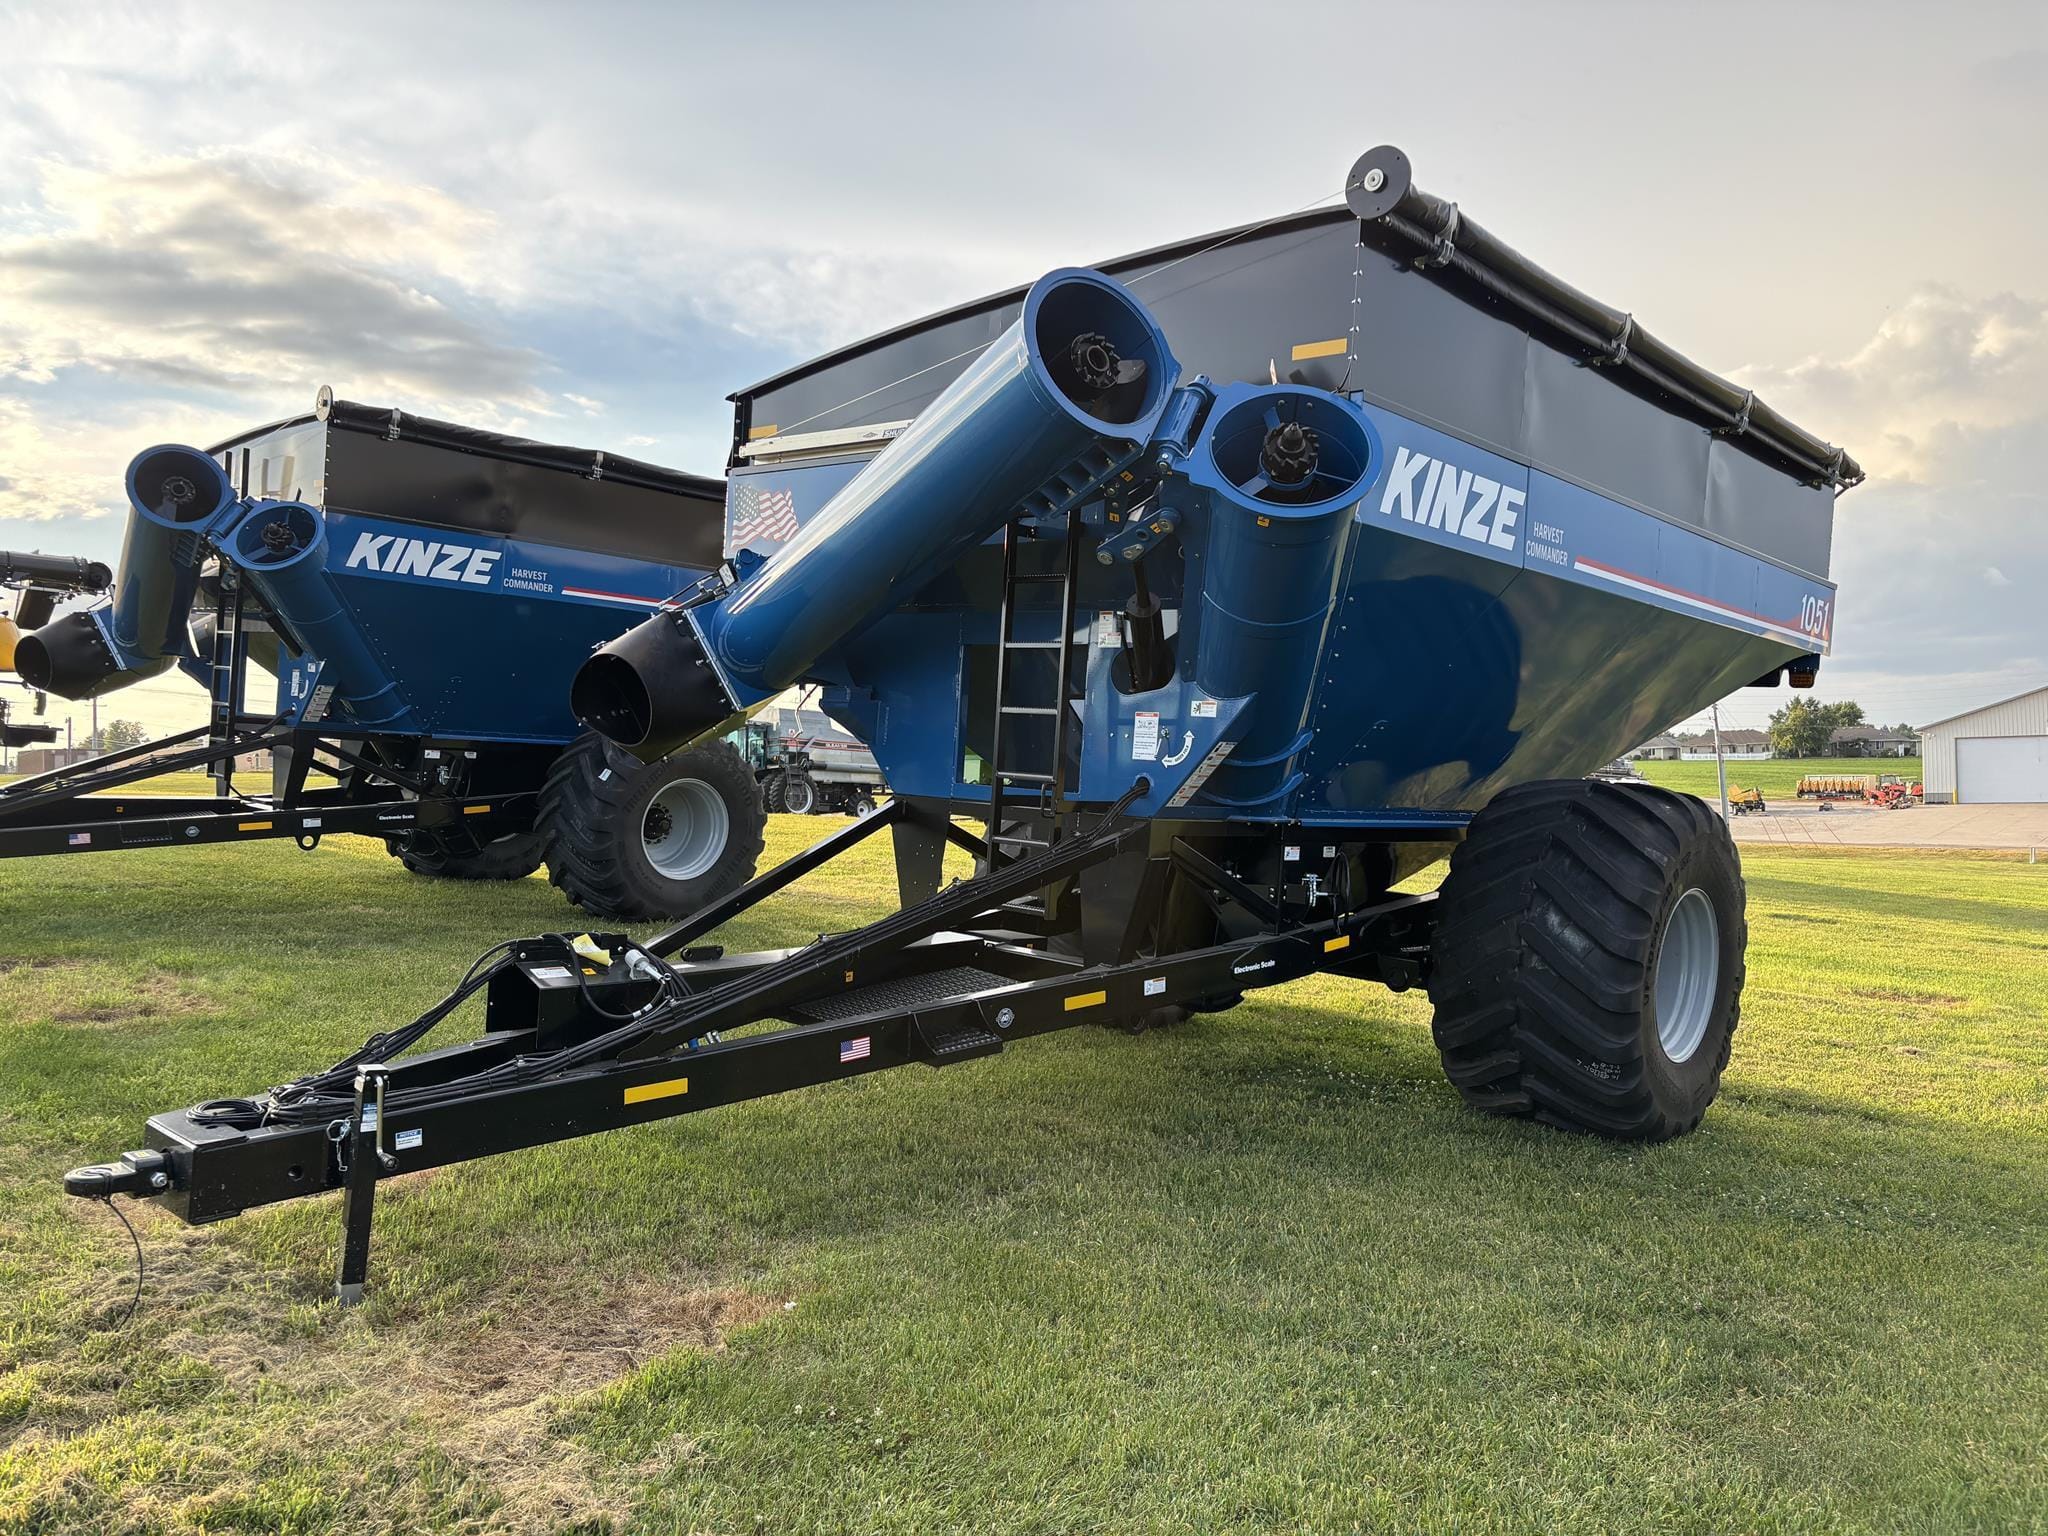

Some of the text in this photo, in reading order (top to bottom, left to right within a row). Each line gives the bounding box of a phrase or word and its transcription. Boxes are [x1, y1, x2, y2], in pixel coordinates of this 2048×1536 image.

[1379, 446, 1527, 551] KINZE
[1533, 521, 1565, 545] HARVEST
[345, 532, 502, 585] KINZE
[1526, 539, 1568, 567] COMMANDER
[503, 578, 553, 593] COMMANDER
[511, 567, 548, 581] HARVEST
[1800, 594, 1829, 636] 1051
[1234, 960, 1275, 974] Electronic Scale
